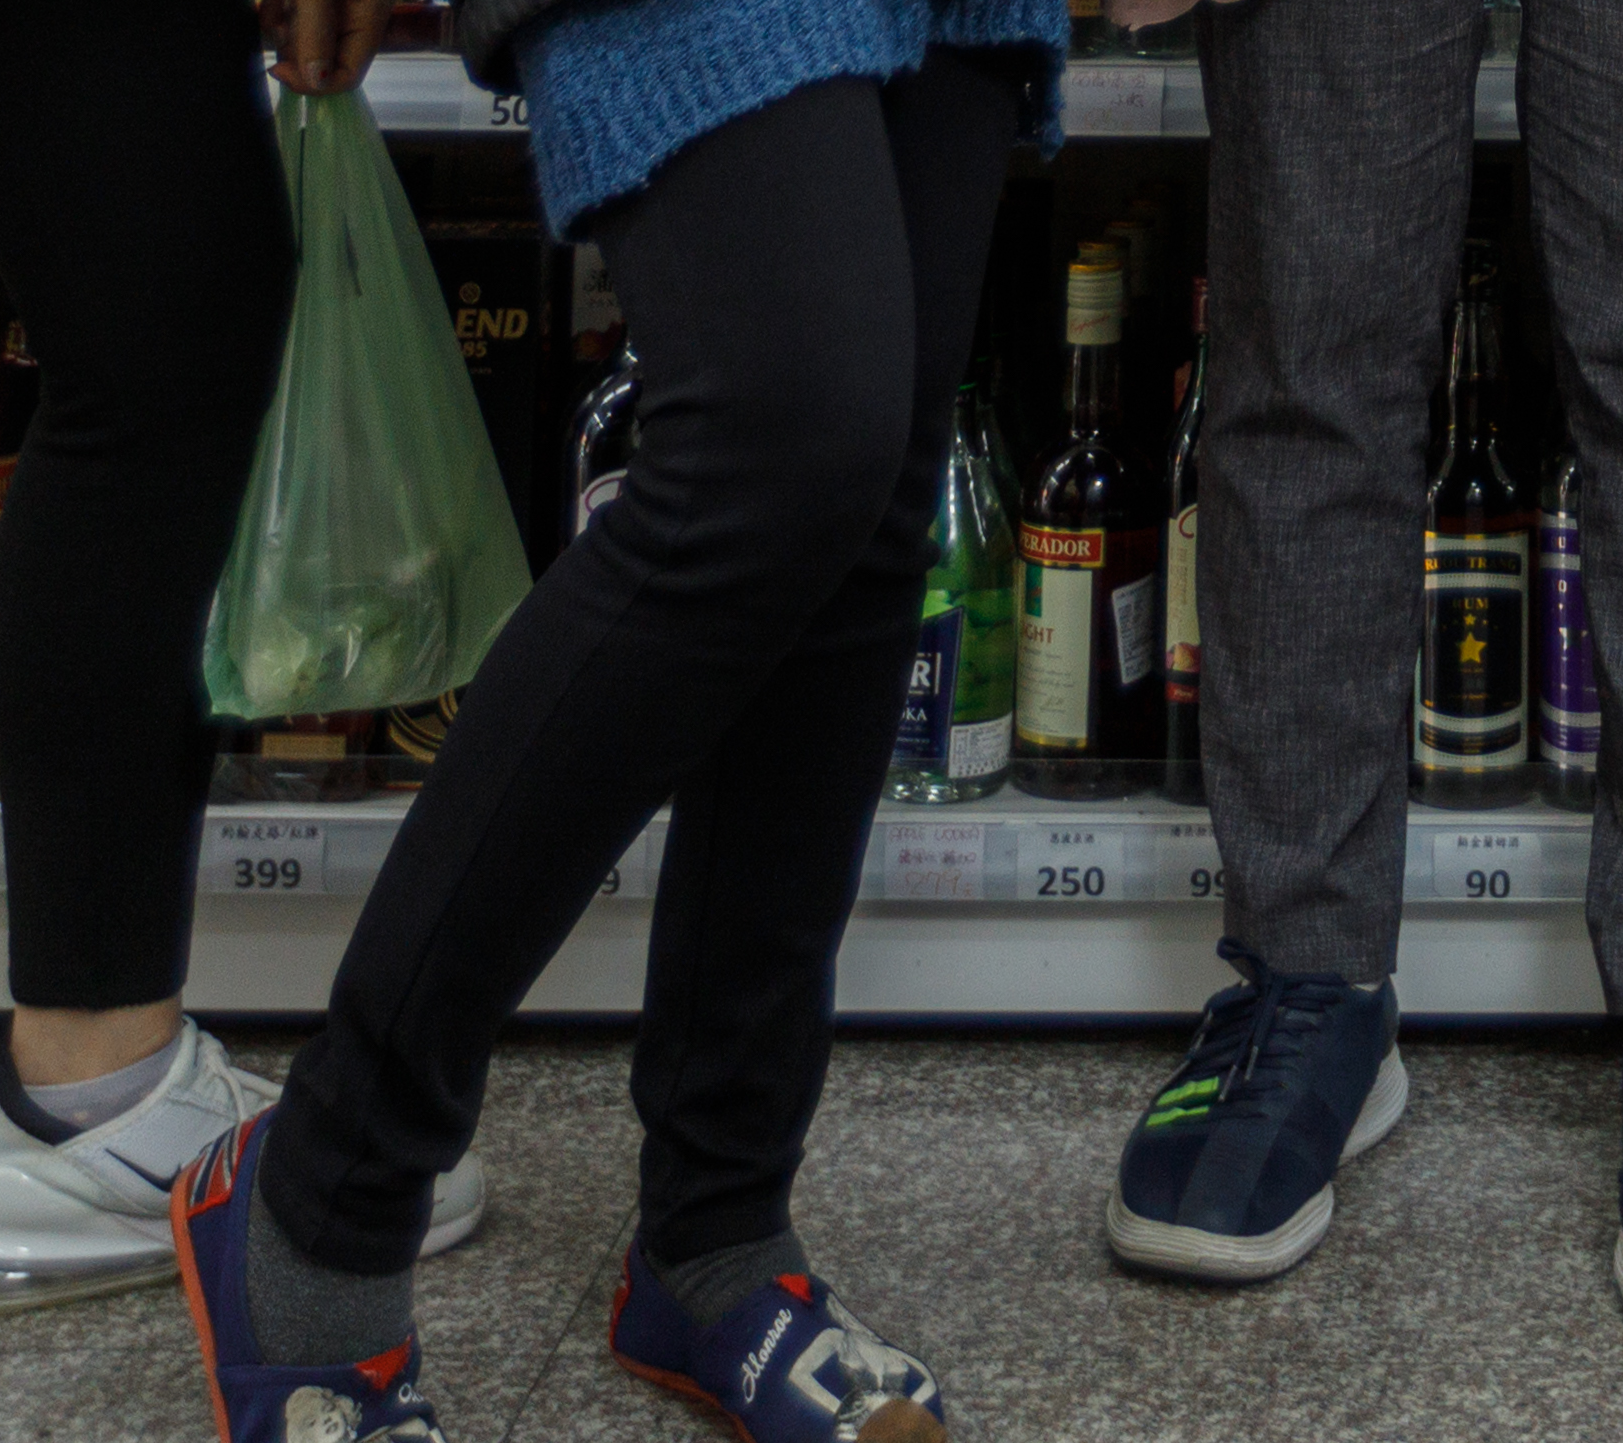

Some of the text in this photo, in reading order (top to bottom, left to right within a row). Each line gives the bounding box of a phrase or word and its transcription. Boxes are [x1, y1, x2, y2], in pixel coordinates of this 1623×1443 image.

[1452, 596, 1490, 612] RUM
[233, 857, 302, 890] 399
[1037, 866, 1105, 897] 250
[1465, 868, 1511, 900] 90
